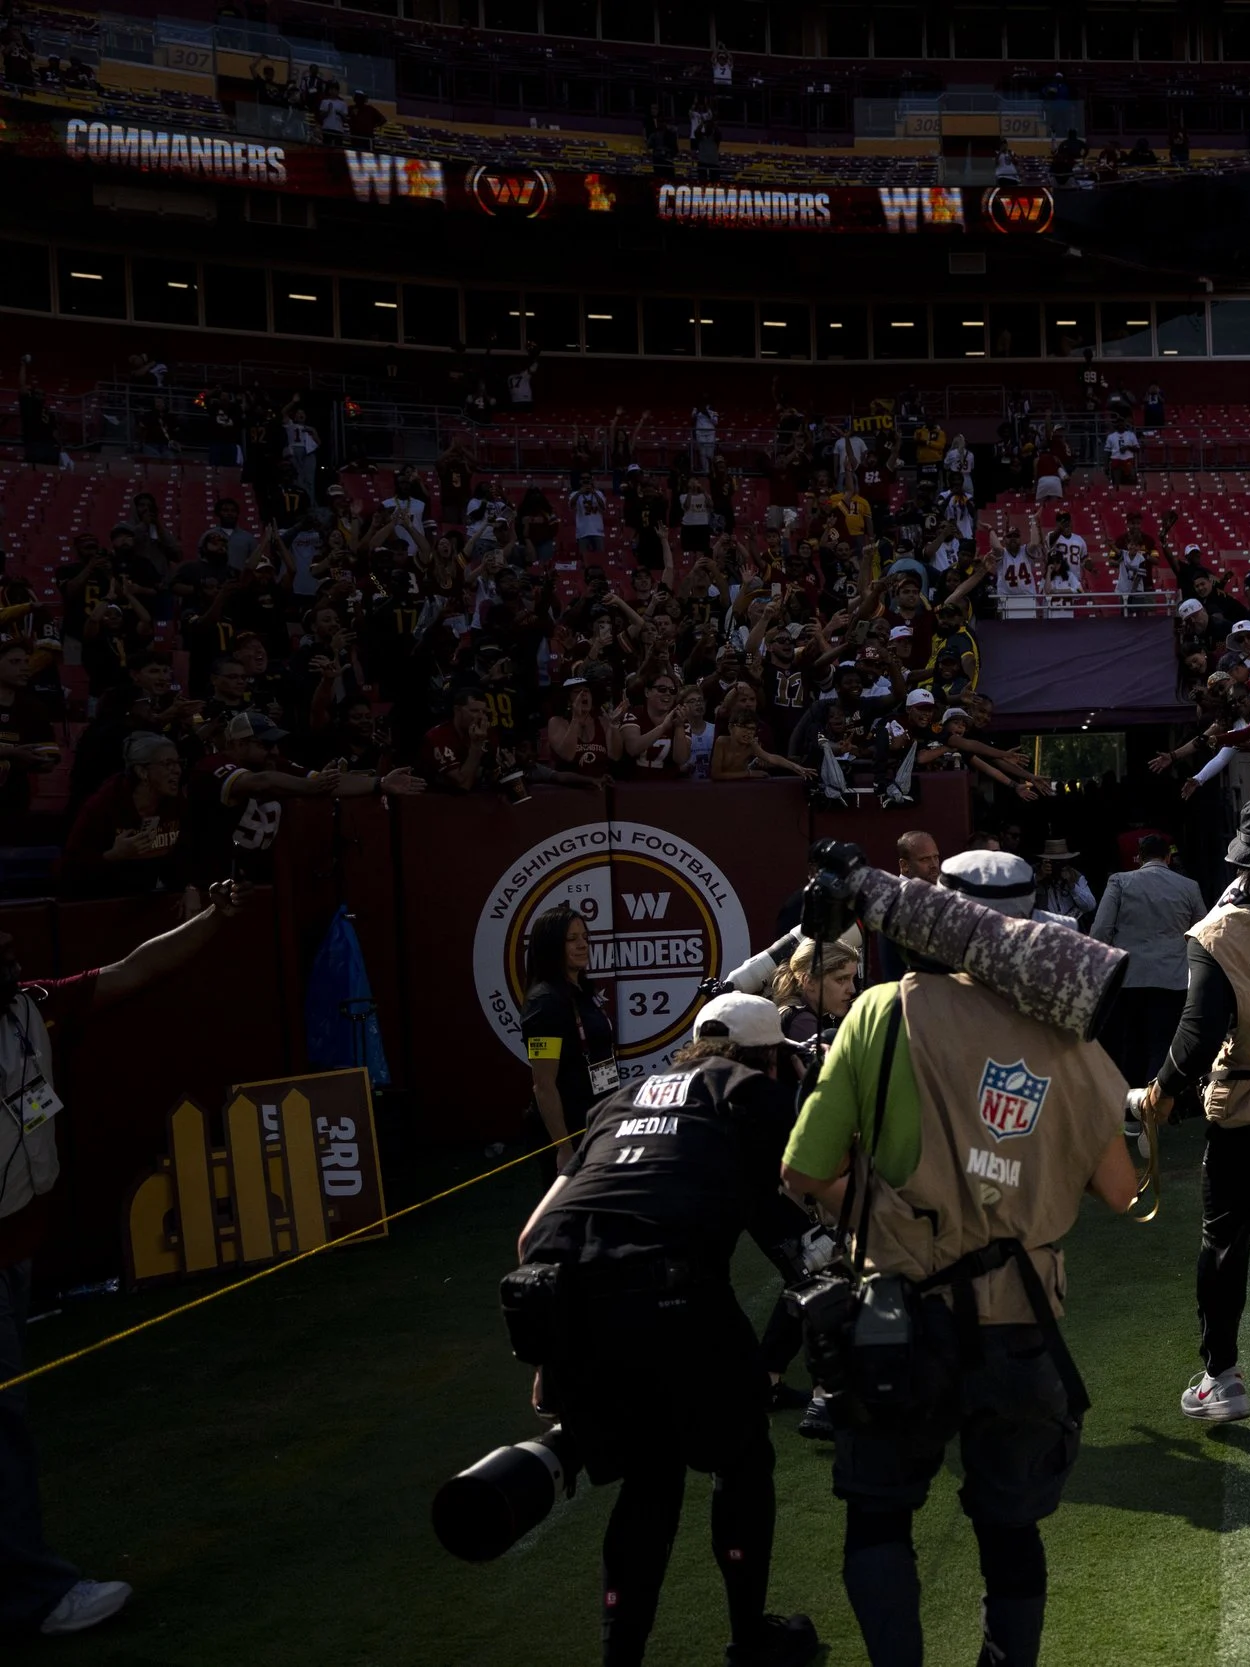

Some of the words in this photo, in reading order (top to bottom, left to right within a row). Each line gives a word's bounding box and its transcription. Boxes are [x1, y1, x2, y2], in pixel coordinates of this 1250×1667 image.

[174, 51, 210, 68] 307
[66, 118, 289, 186] COMMANDERS
[656, 183, 831, 227] COMMANDERS
[1004, 562, 1031, 588] 44
[776, 672, 804, 708] 17
[636, 738, 673, 769] 17
[491, 829, 622, 920] WASHINGTON
[631, 830, 728, 909] FOOTBALL
[567, 884, 590, 893] EST
[587, 937, 704, 971] MANDERS
[488, 989, 522, 1035] 1937
[629, 990, 670, 1017] 32
[617, 1064, 646, 1081] 82
[615, 1115, 679, 1139] MEDIA
[982, 1090, 1028, 1130] NFL
[316, 1116, 363, 1197] 3RD
[614, 1145, 646, 1165] 11
[965, 1146, 1023, 1189] MEDIA
